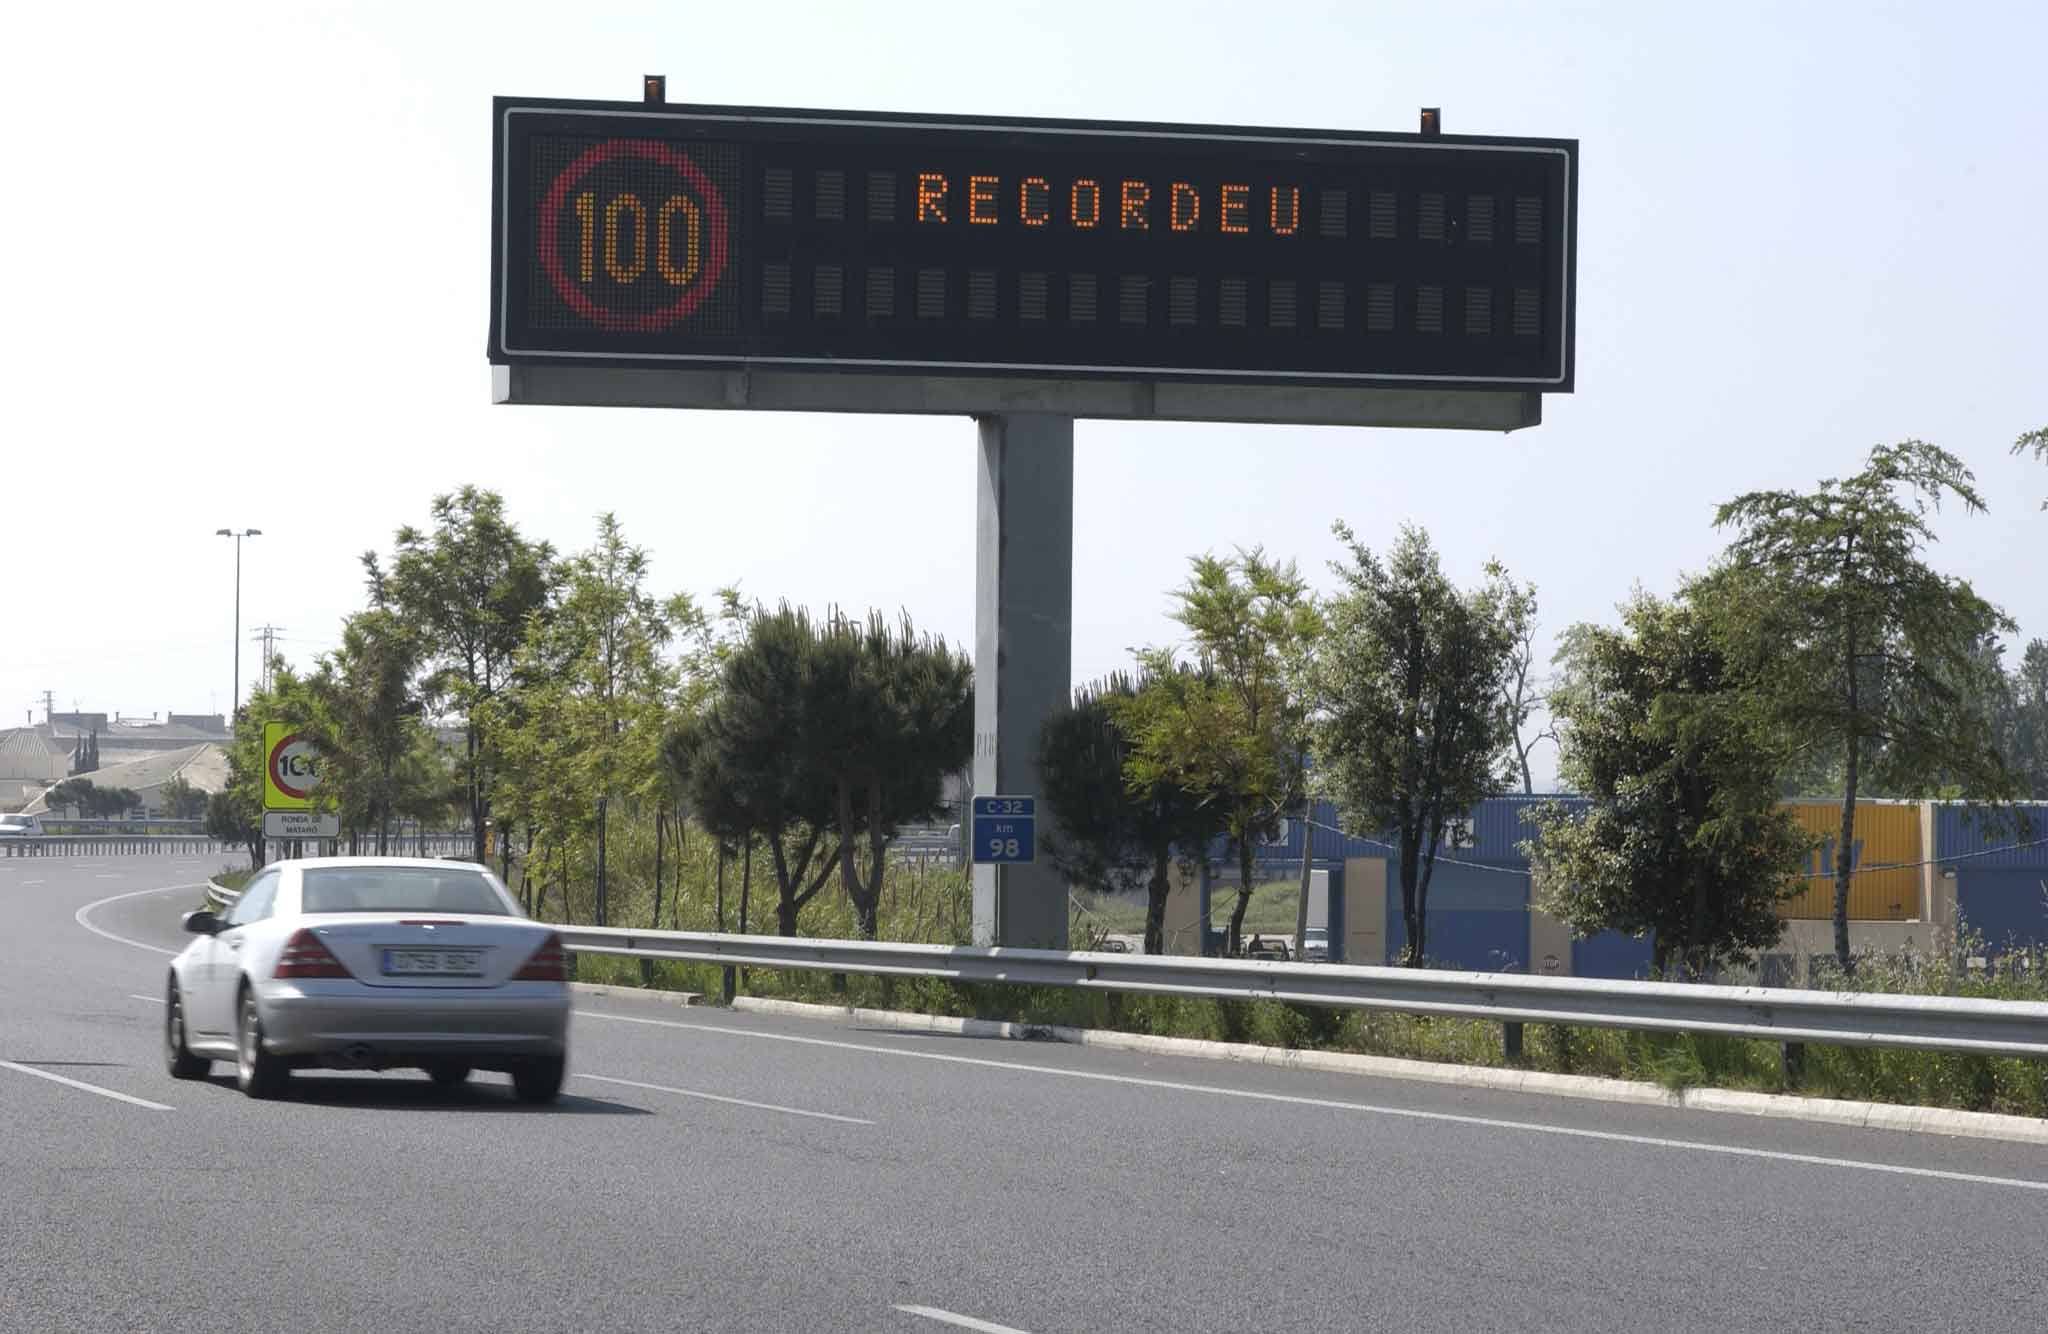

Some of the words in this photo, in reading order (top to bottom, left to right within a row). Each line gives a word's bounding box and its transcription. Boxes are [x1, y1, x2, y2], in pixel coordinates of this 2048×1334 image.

[918, 174, 1299, 234] RECORDEU
[576, 192, 699, 285] 100
[987, 800, 1024, 813] C-32
[996, 824, 1013, 832] km
[990, 839, 1019, 857] 98
